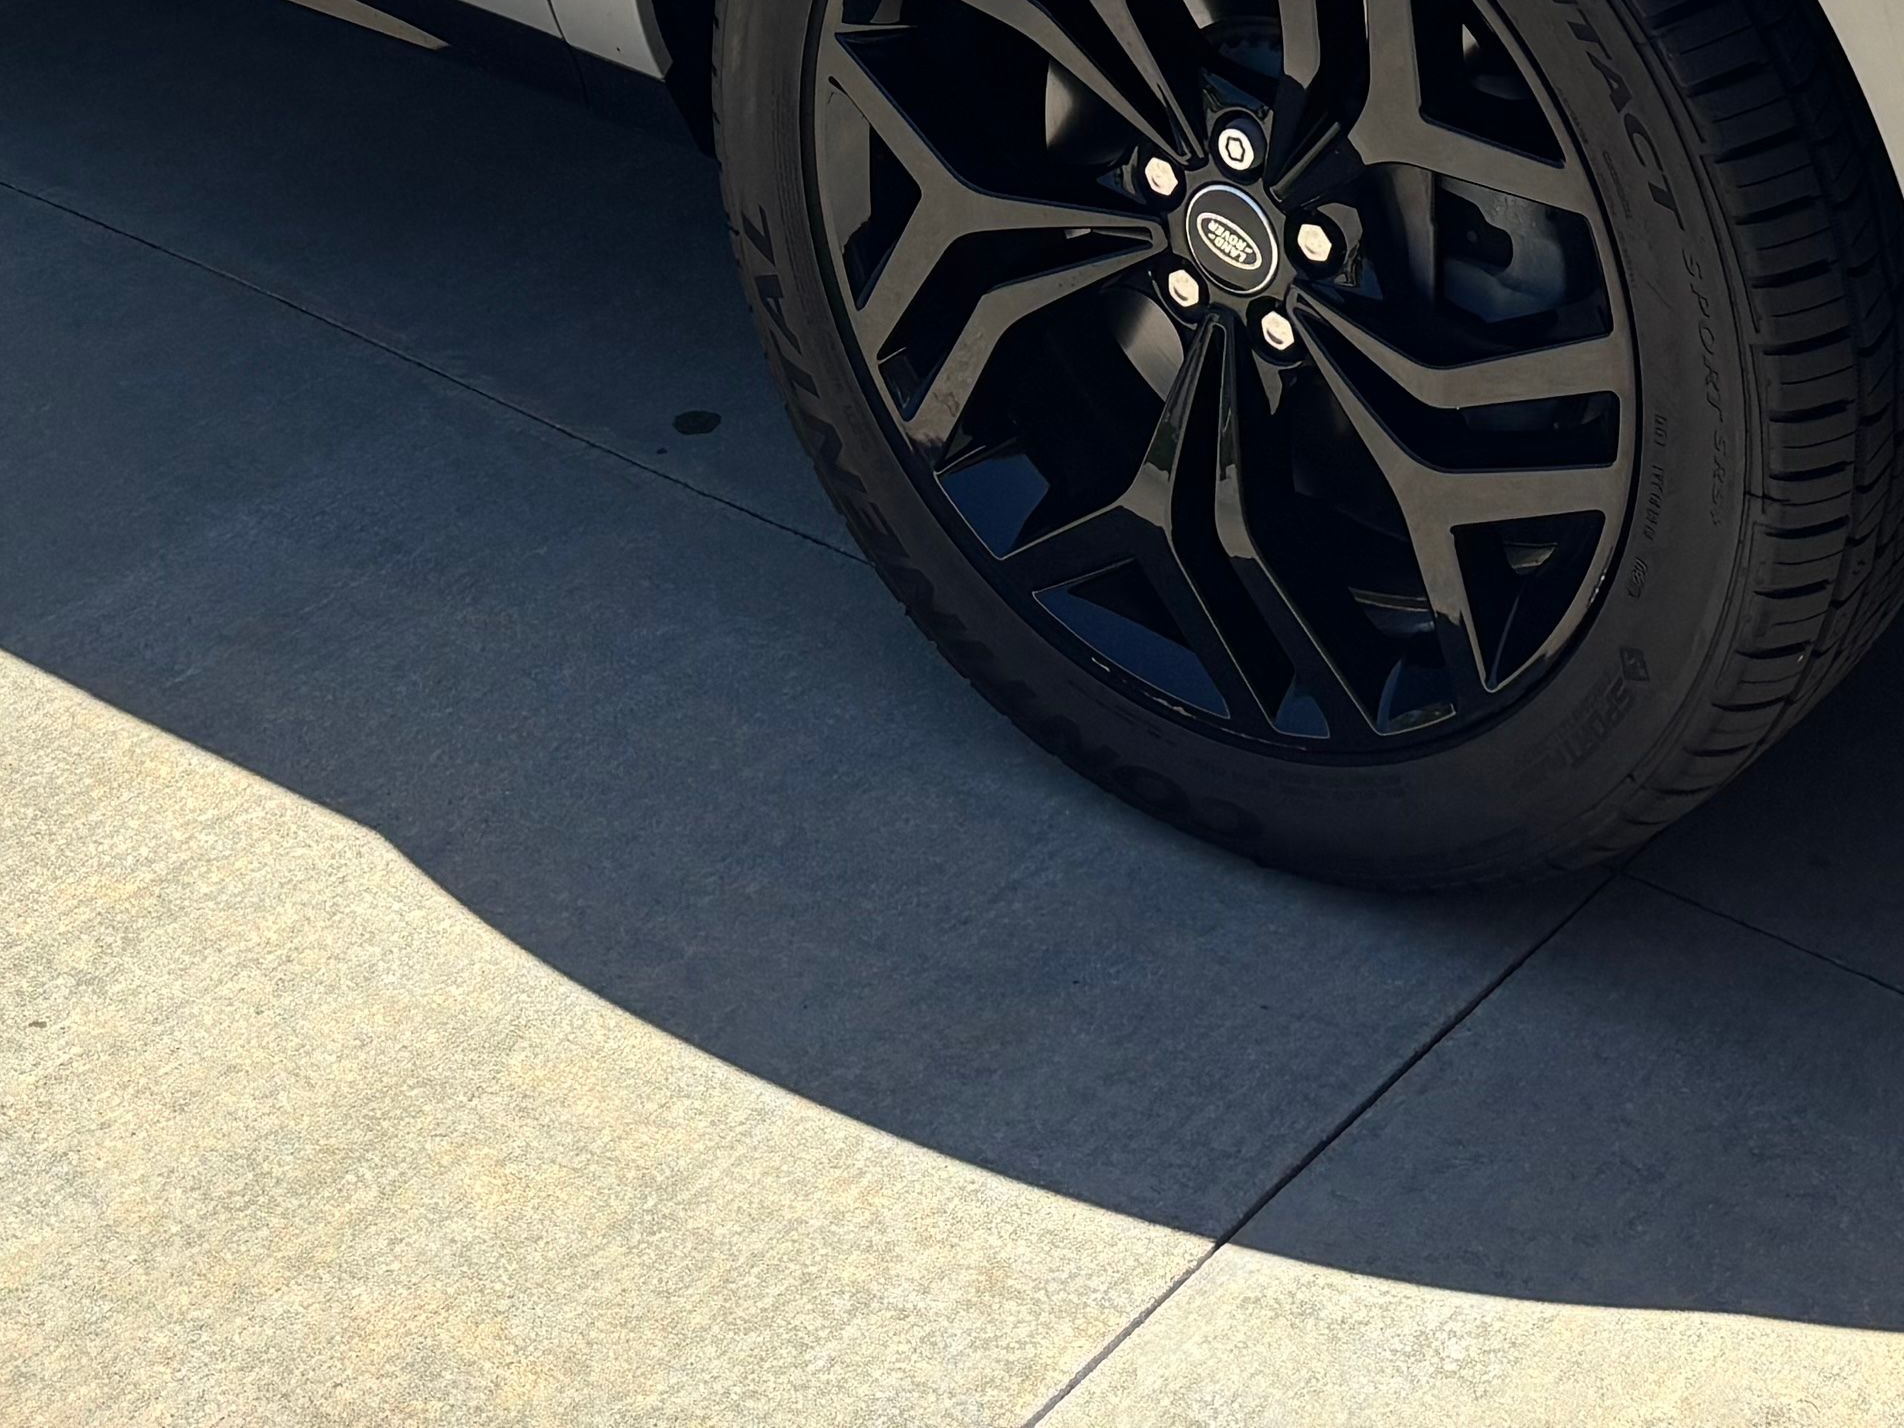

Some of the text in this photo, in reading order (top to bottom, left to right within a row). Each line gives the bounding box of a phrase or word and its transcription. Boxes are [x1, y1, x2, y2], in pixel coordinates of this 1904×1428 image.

[1208, 220, 1247, 250] ROVER
[1213, 236, 1247, 262] LAND
[1681, 248, 1723, 421] SPORT
